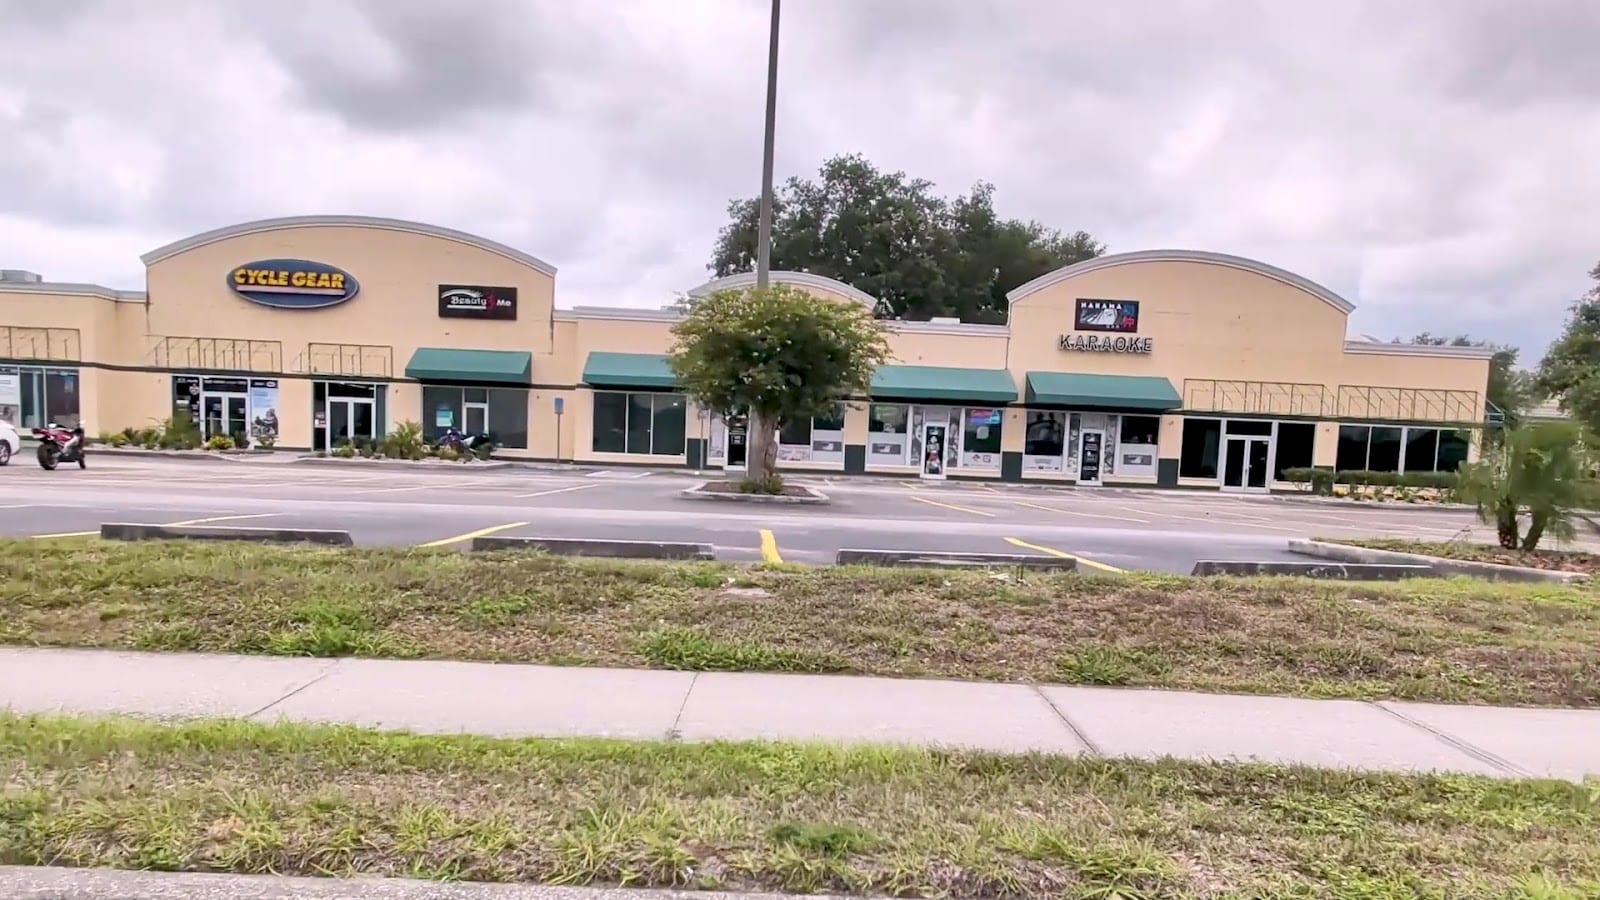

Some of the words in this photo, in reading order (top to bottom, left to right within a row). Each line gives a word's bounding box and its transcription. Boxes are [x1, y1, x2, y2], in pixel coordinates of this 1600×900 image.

[235, 268, 289, 287] CYCLE
[291, 270, 346, 289] GEAR
[450, 296, 487, 306] Beauty
[496, 299, 512, 307] Me
[1059, 334, 1153, 354] KARAOKE
